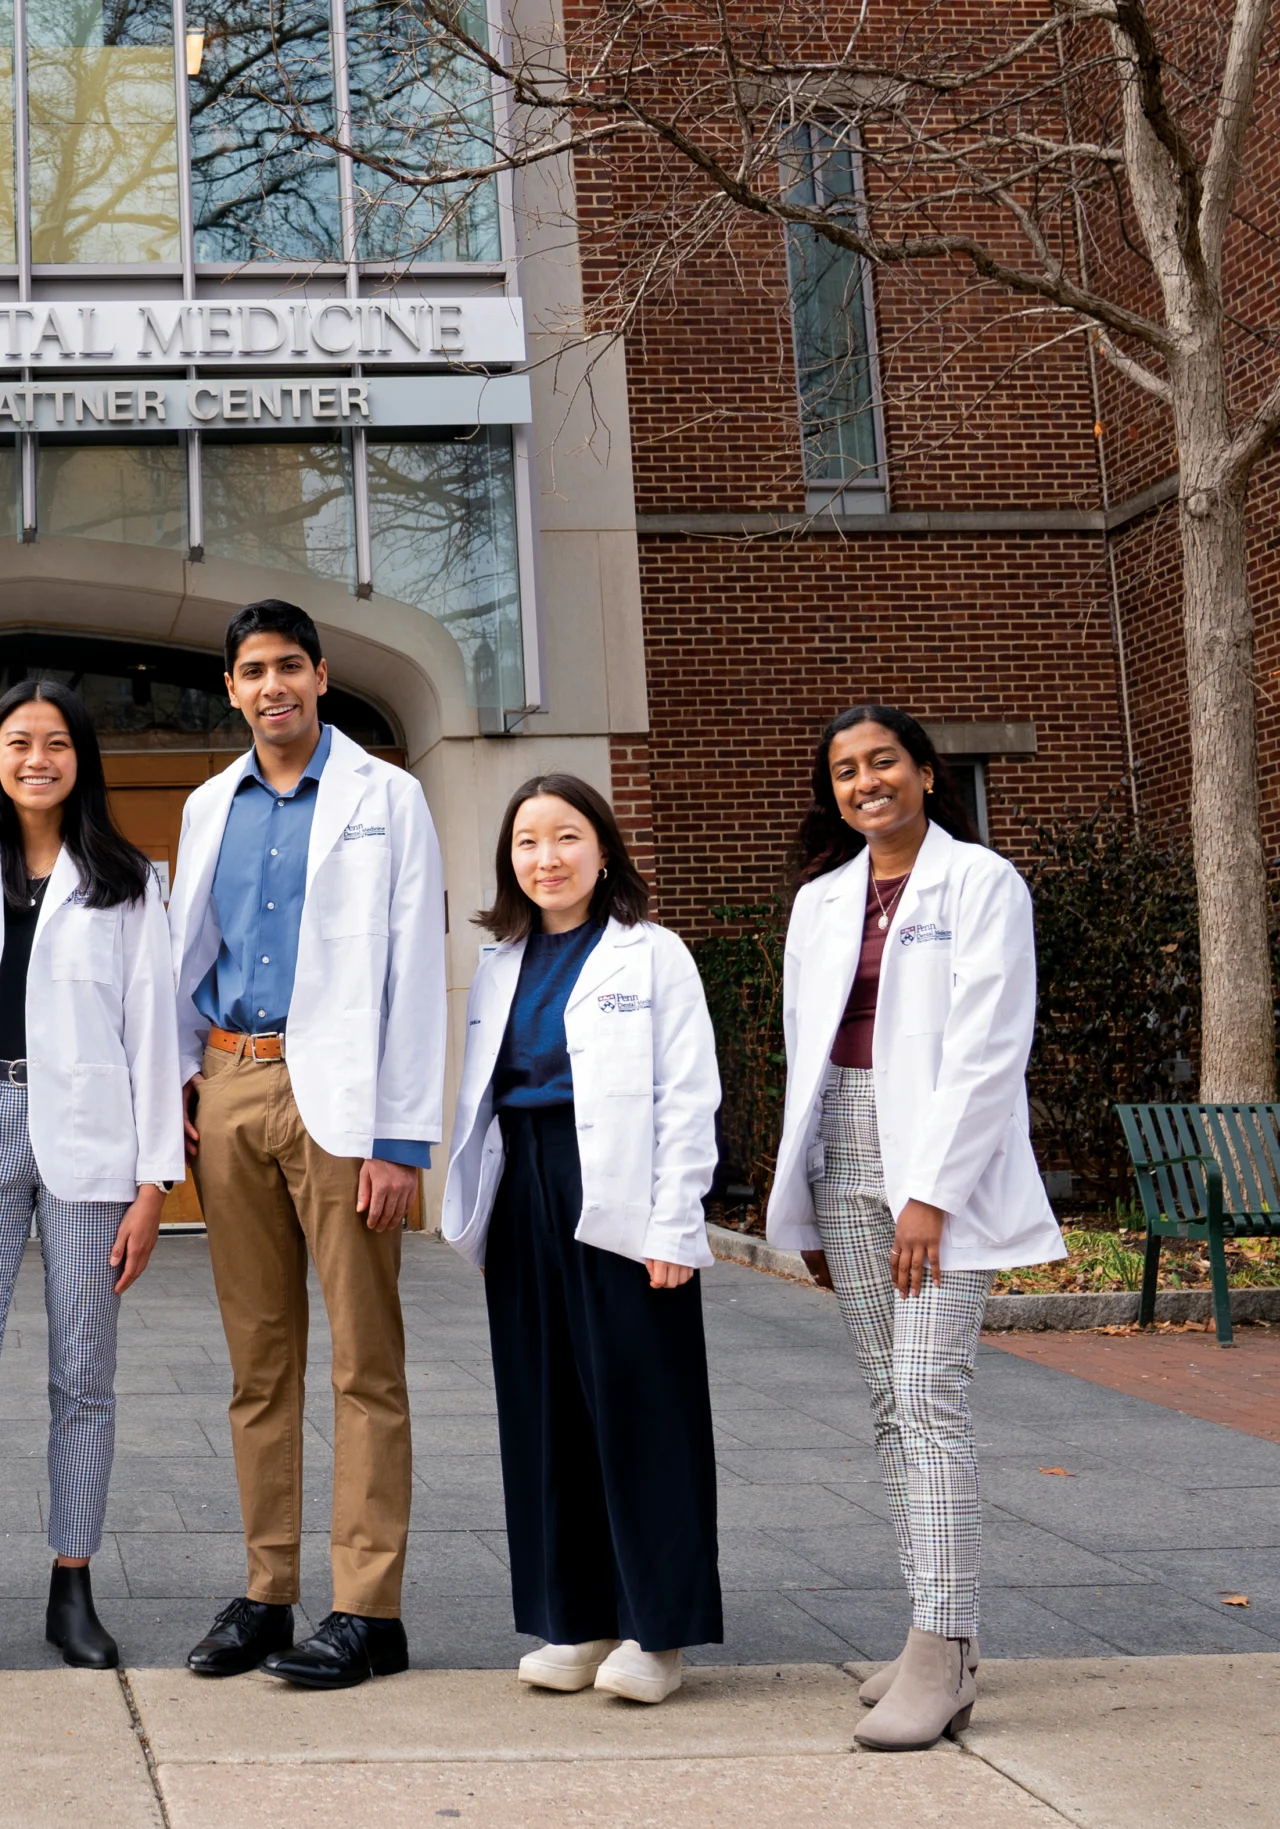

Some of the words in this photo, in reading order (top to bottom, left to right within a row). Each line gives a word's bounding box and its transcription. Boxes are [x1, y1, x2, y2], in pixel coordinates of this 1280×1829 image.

[137, 304, 466, 357] MEDICINE
[187, 381, 371, 421] CENTER
[916, 923, 936, 933] Penn
[616, 993, 638, 1002] Penn
